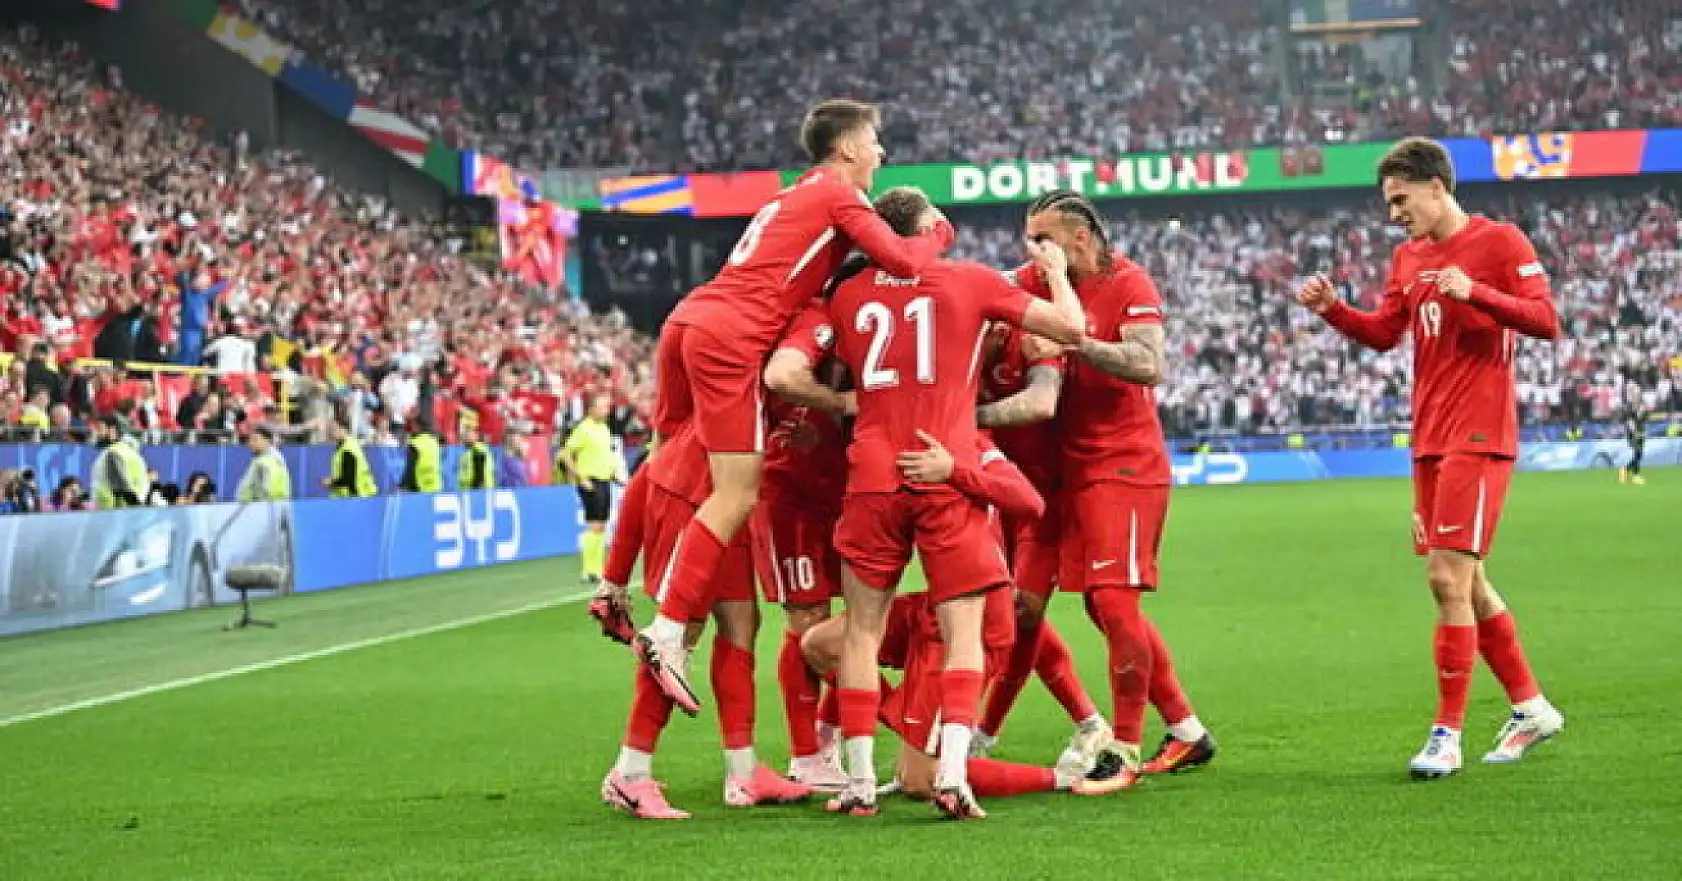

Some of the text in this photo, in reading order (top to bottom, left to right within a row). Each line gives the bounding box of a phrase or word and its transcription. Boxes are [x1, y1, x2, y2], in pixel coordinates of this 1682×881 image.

[855, 296, 936, 391] 21
[1419, 301, 1441, 337] 19
[434, 488, 521, 568] BYD
[783, 556, 815, 591] 10
